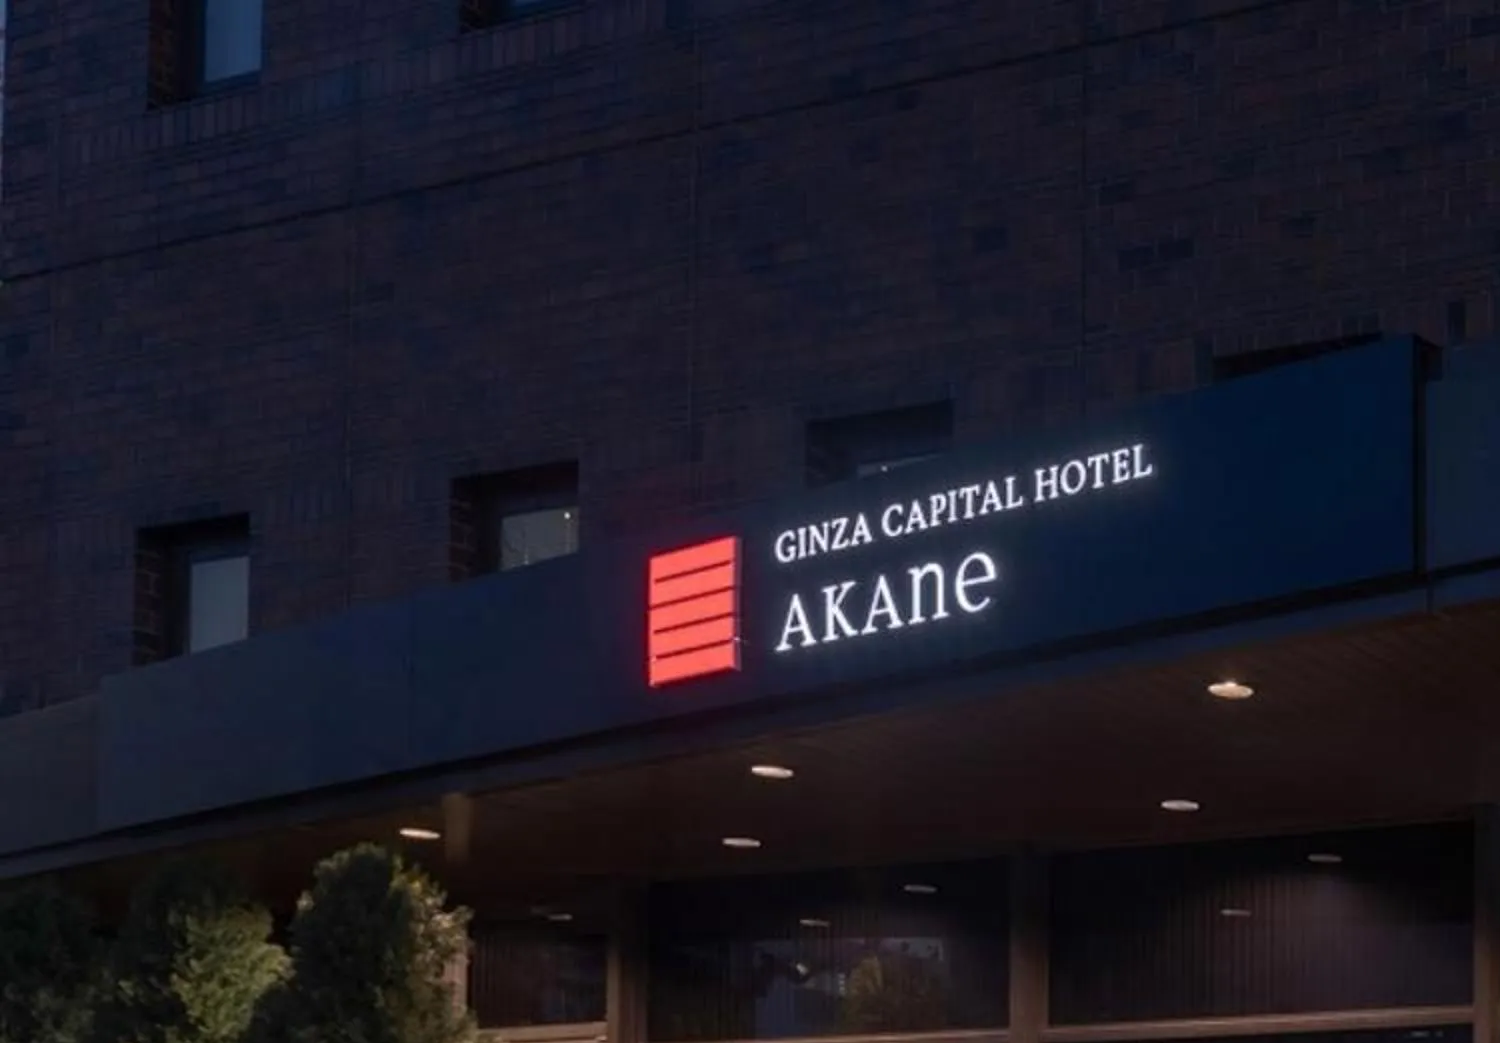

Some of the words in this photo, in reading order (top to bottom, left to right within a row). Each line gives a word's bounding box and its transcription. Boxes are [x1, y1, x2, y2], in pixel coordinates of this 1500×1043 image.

[774, 512, 874, 564] GINZA
[880, 475, 1025, 538] CAPITAL
[1034, 443, 1154, 503] HOTEL
